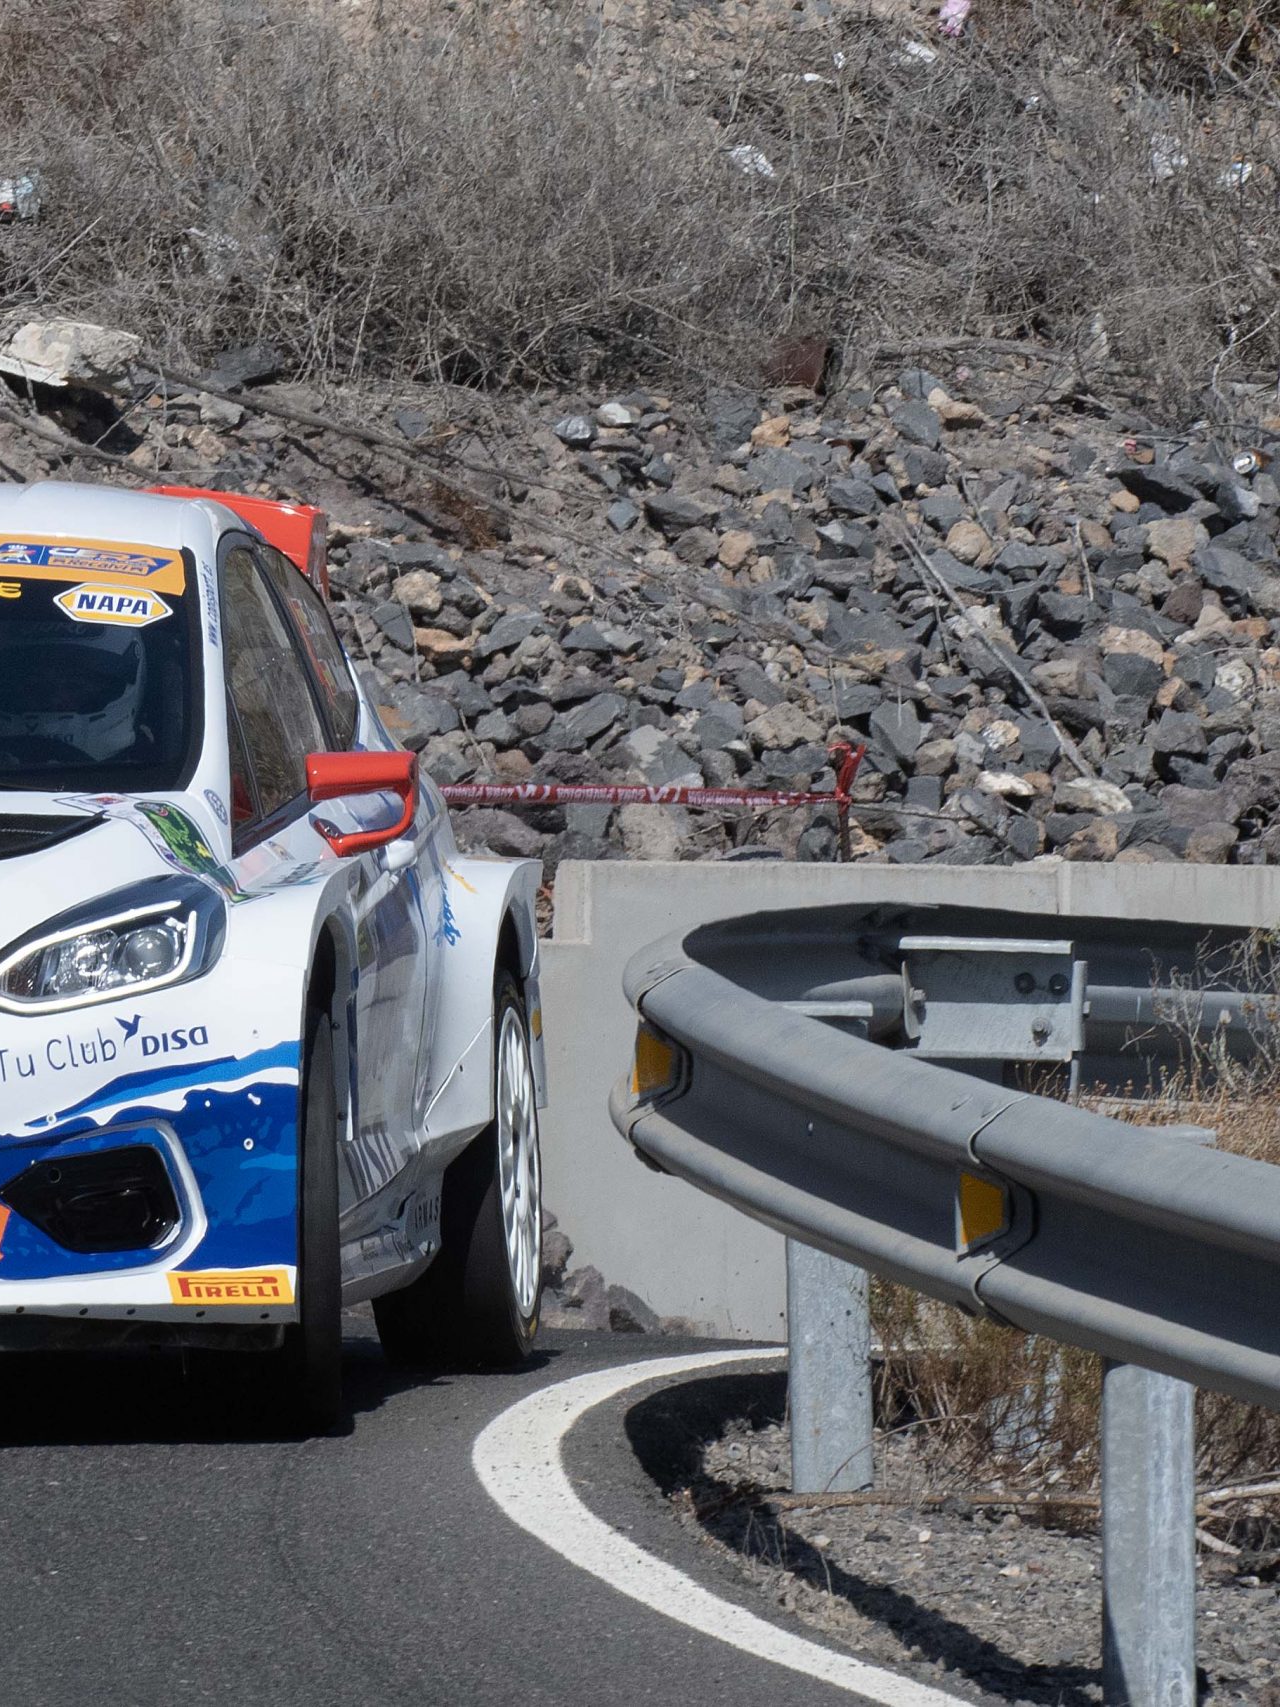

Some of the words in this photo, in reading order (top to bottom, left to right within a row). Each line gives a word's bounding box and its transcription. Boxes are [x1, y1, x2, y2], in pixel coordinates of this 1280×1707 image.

[76, 592, 150, 617] NAPA
[46, 1028, 117, 1069] Club
[179, 1276, 280, 1298] PIRELLI
